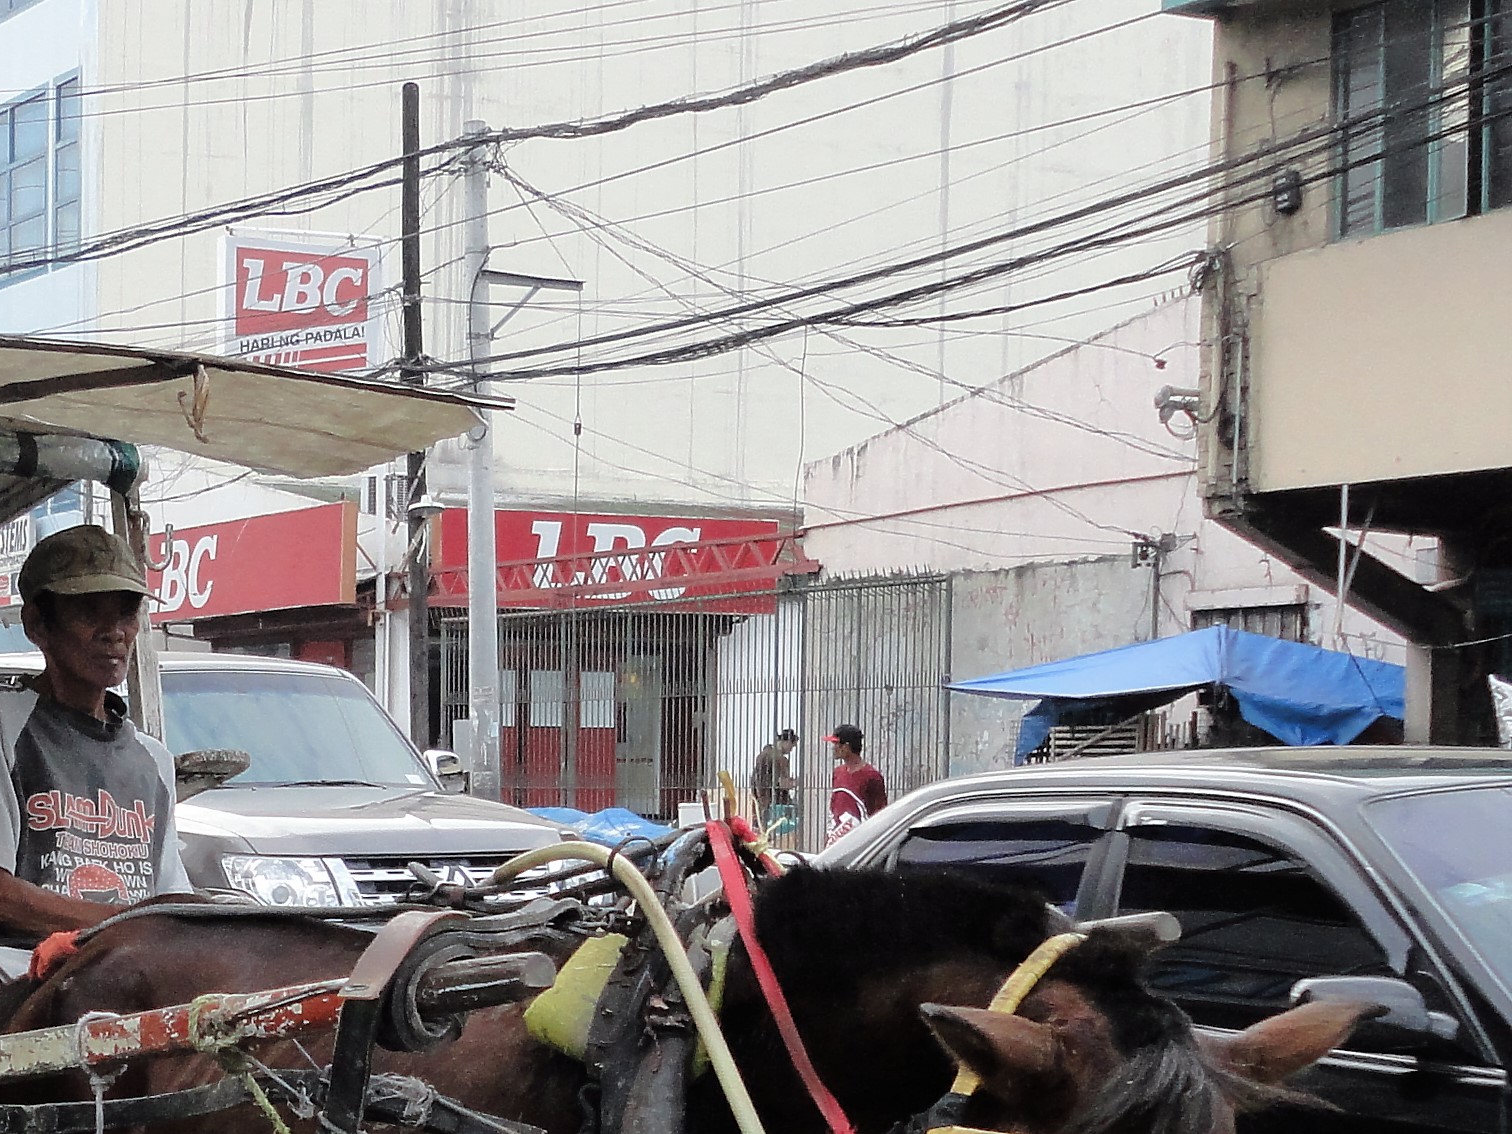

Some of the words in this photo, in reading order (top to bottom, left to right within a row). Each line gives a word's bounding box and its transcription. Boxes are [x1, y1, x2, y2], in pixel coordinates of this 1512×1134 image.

[242, 258, 364, 317] LBC
[240, 337, 275, 352] HARI
[279, 333, 300, 345] NG
[305, 326, 365, 345] PADALA!
[149, 534, 218, 614] BC
[531, 520, 702, 601] LBC
[82, 838, 149, 859] SHOHOKU
[113, 860, 136, 876] HO
[139, 861, 154, 875] IS
